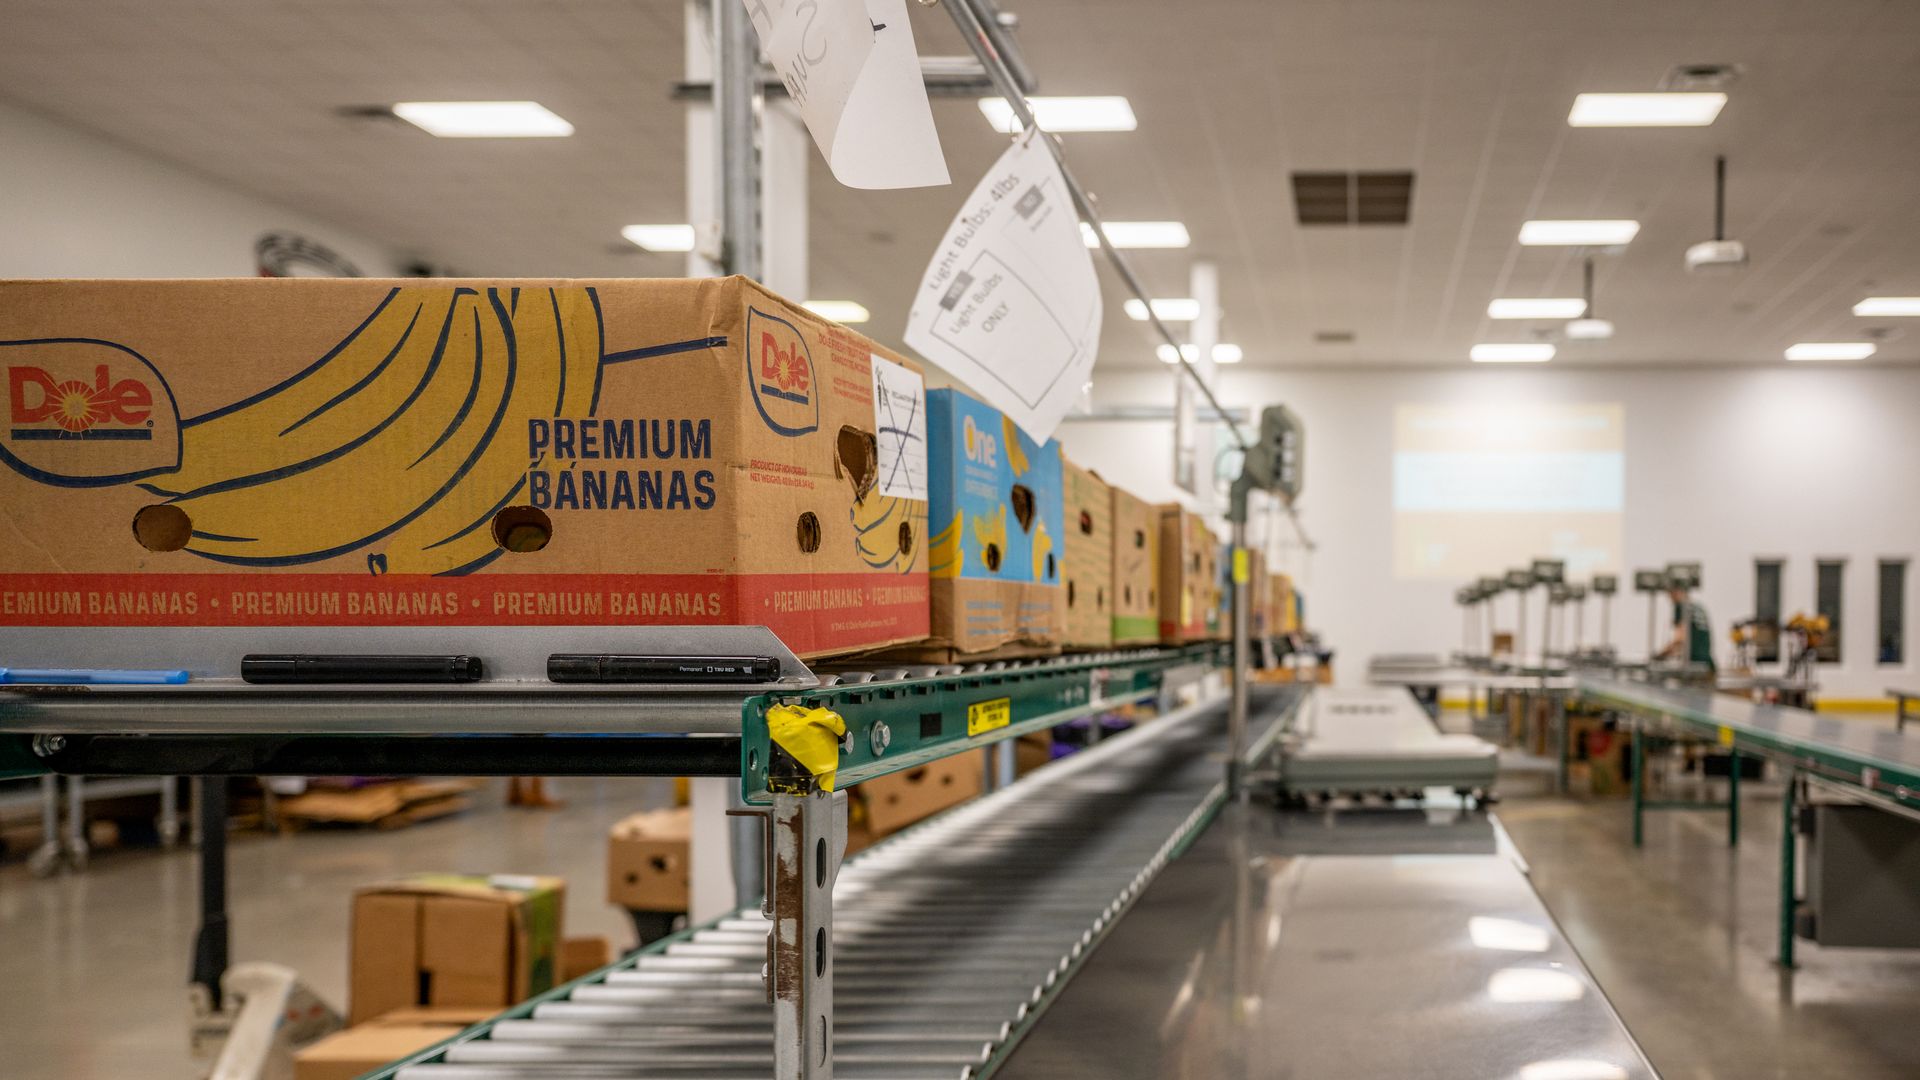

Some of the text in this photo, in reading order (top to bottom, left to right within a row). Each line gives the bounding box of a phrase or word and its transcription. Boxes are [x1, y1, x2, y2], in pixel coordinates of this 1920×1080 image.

[929, 252, 958, 289] Light
[949, 273, 1002, 333] Light Bulbs
[982, 302, 1009, 332] ONLY
[762, 331, 809, 392] Dole
[8, 365, 153, 432] Dole
[528, 418, 712, 459] PREMIUM
[964, 415, 997, 470] One
[528, 470, 716, 510] BANANAS
[88, 591, 198, 615] BANANAS
[231, 591, 340, 615] PREMIUM
[347, 591, 459, 615] BANANAS
[493, 592, 601, 616] PREMIUM
[610, 592, 722, 616] BANANAS
[774, 590, 821, 613] PREMIUM
[823, 587, 863, 610] BANANAS
